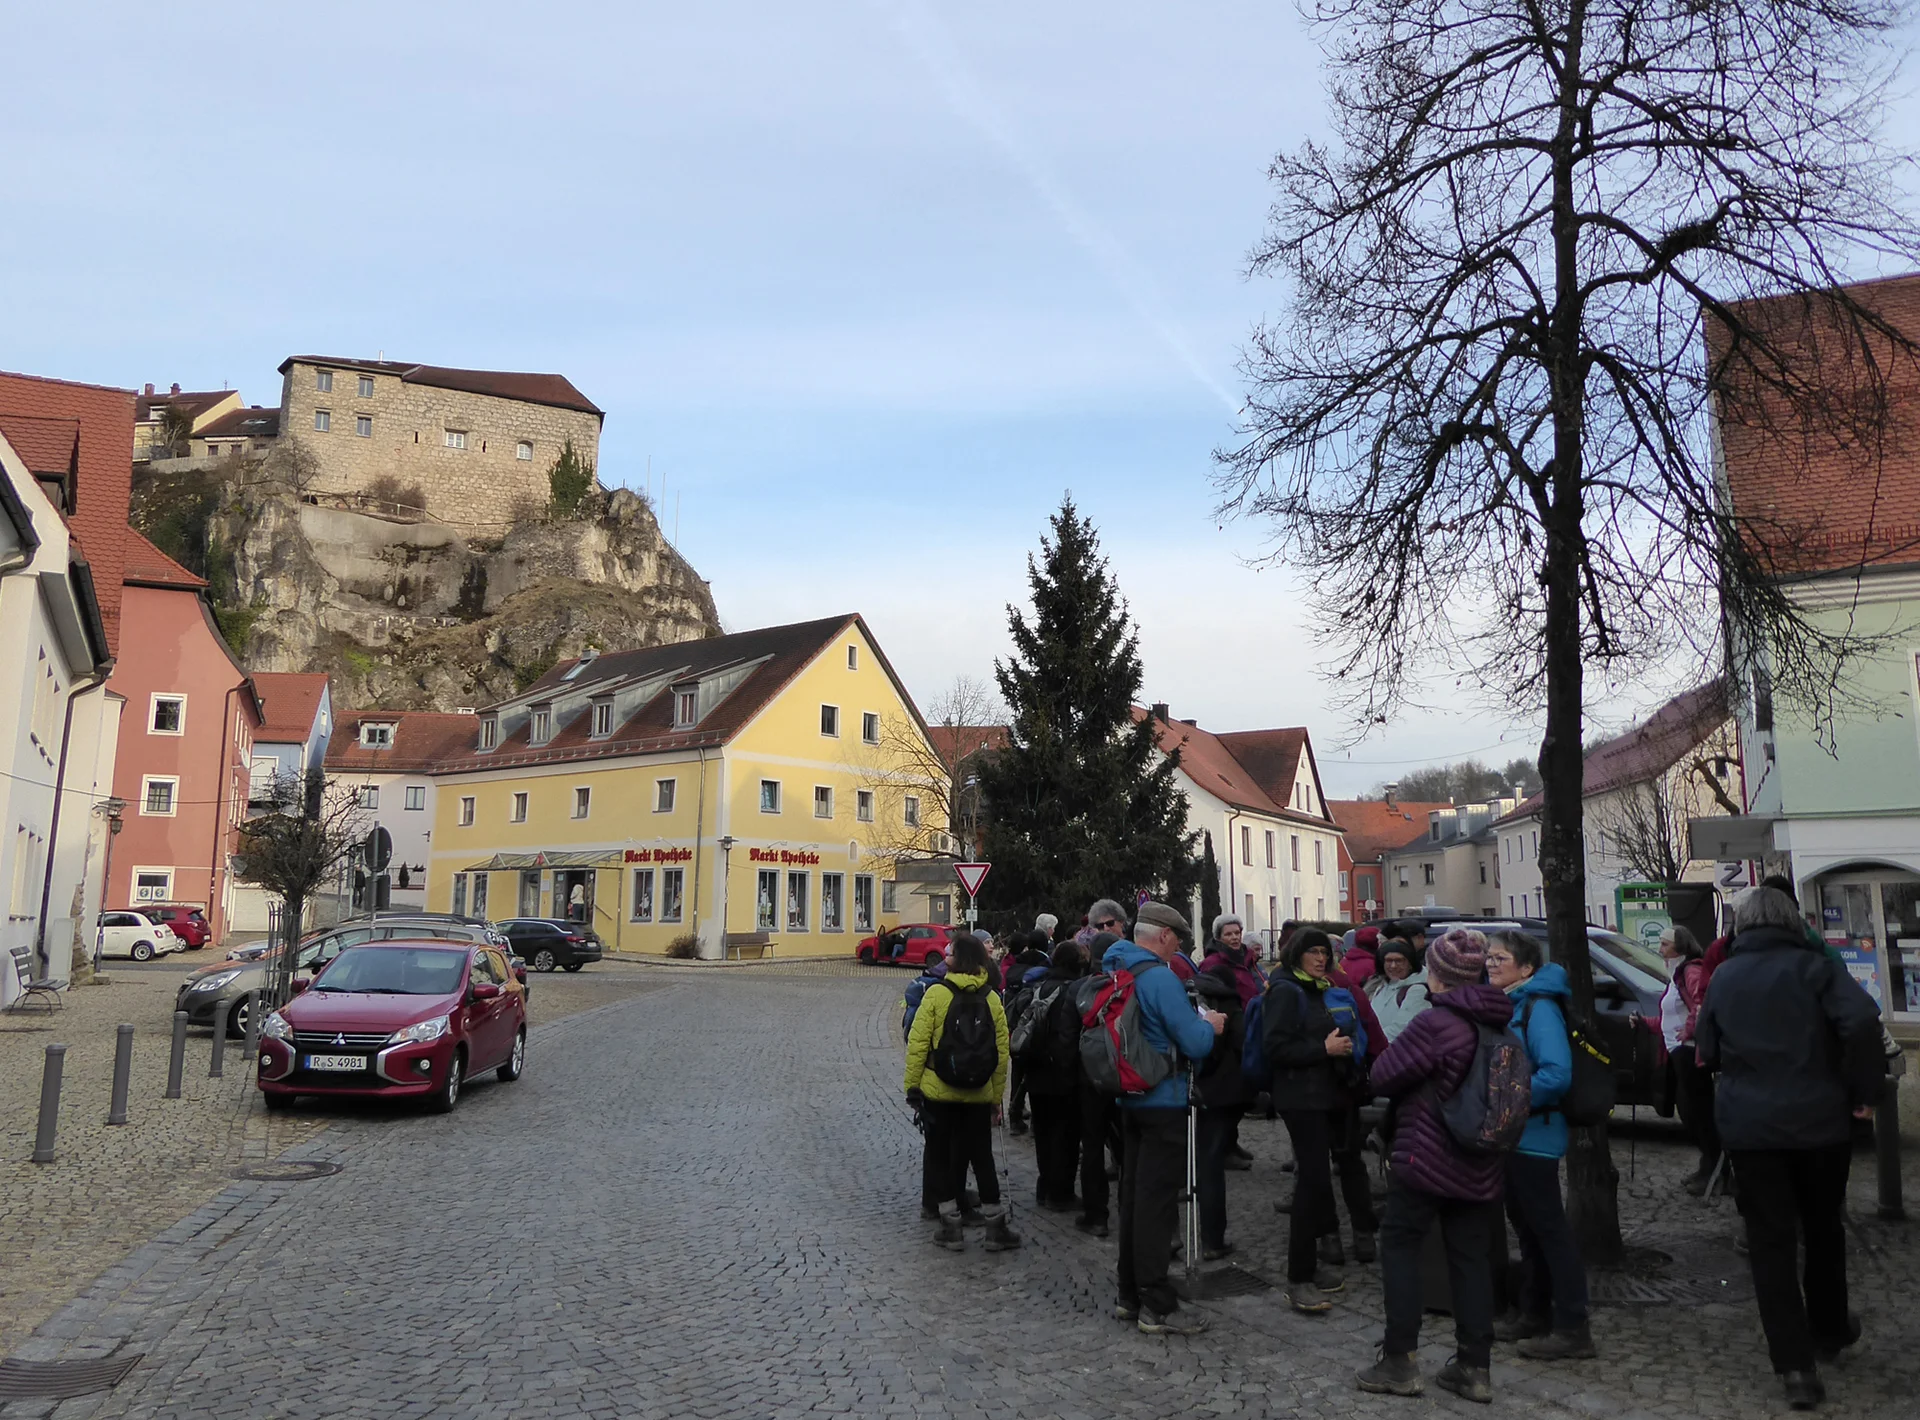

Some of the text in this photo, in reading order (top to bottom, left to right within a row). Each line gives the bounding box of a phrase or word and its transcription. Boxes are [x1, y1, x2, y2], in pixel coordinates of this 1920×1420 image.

[624, 847, 692, 865] Markt Apotheke
[749, 848, 820, 867] Markt Apotheke
[313, 1056, 363, 1068] R S 4981
